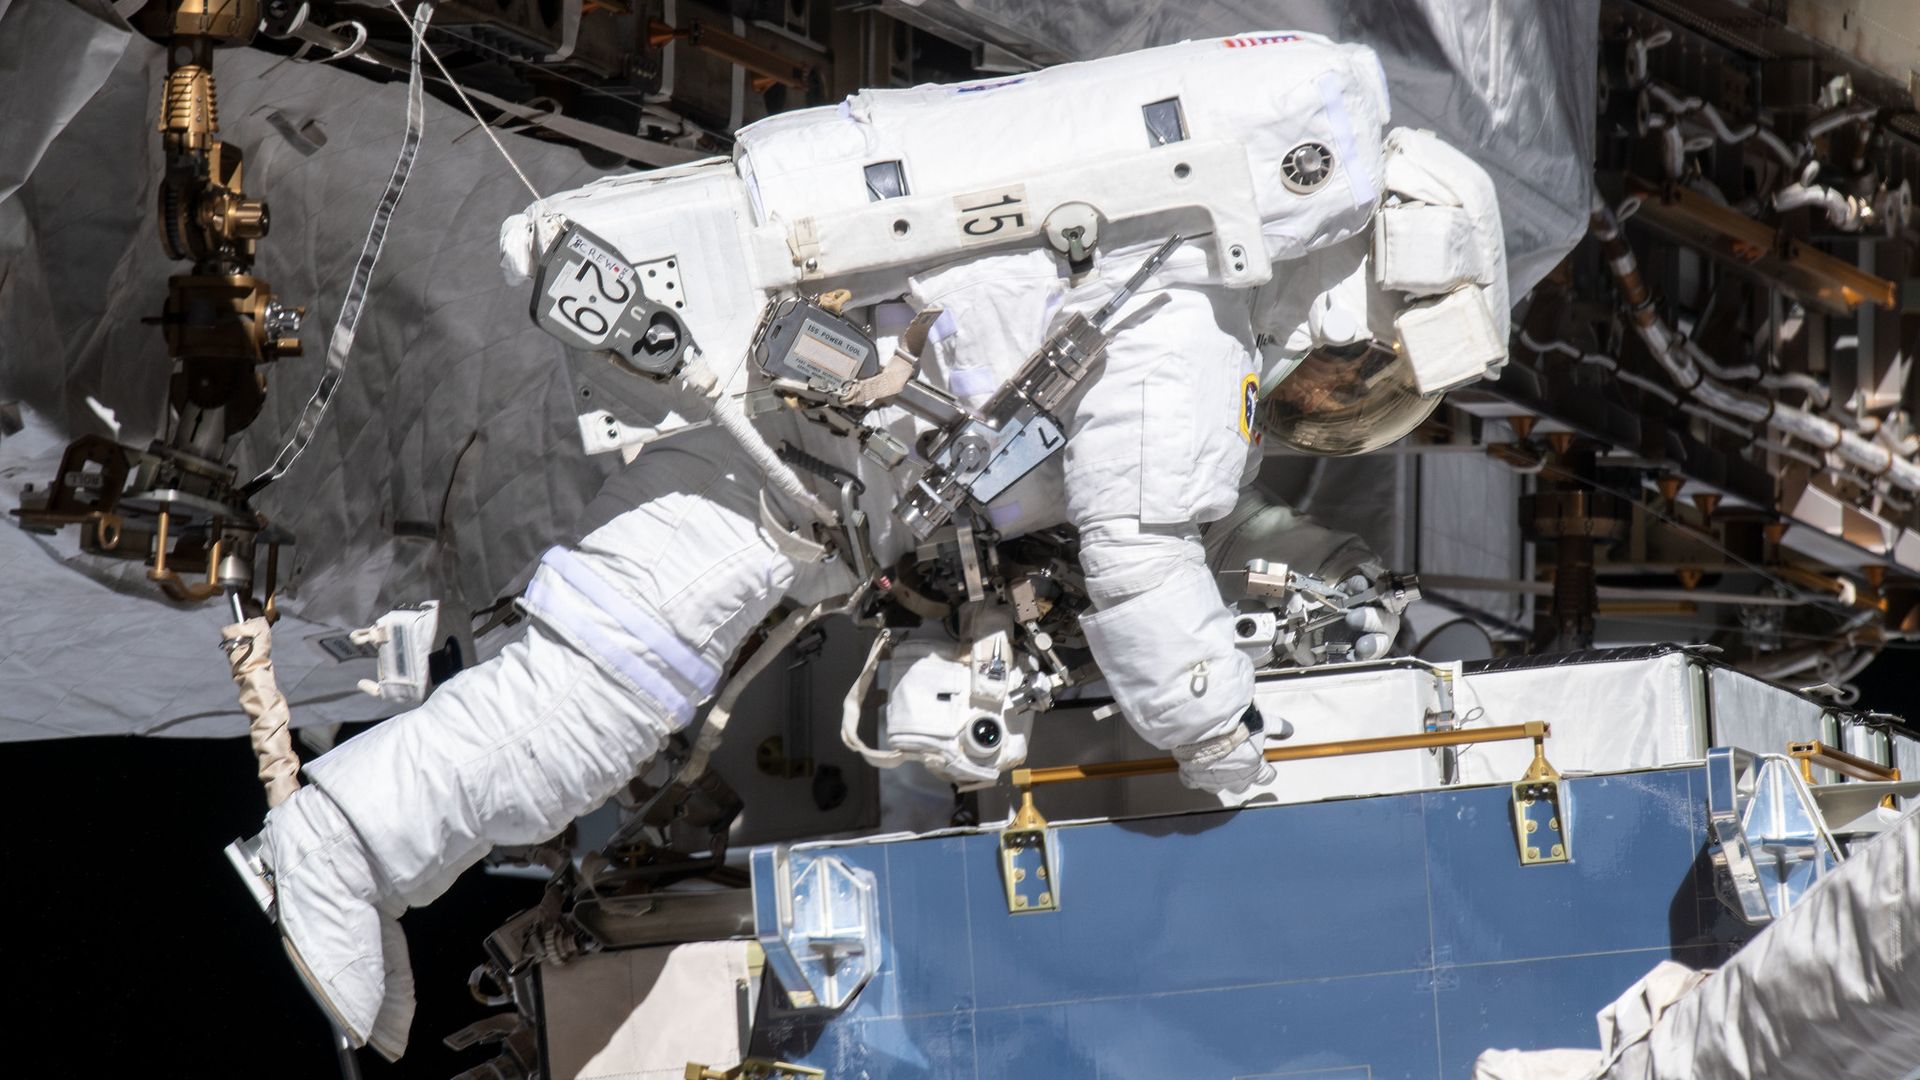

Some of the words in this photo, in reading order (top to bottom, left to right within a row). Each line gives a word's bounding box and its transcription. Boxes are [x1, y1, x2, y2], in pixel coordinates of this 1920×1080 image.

[962, 194, 1024, 235] 15
[558, 259, 629, 336] 29
[807, 324, 819, 334] ISS
[821, 331, 843, 346] POWER
[846, 345, 860, 356] TOOL
